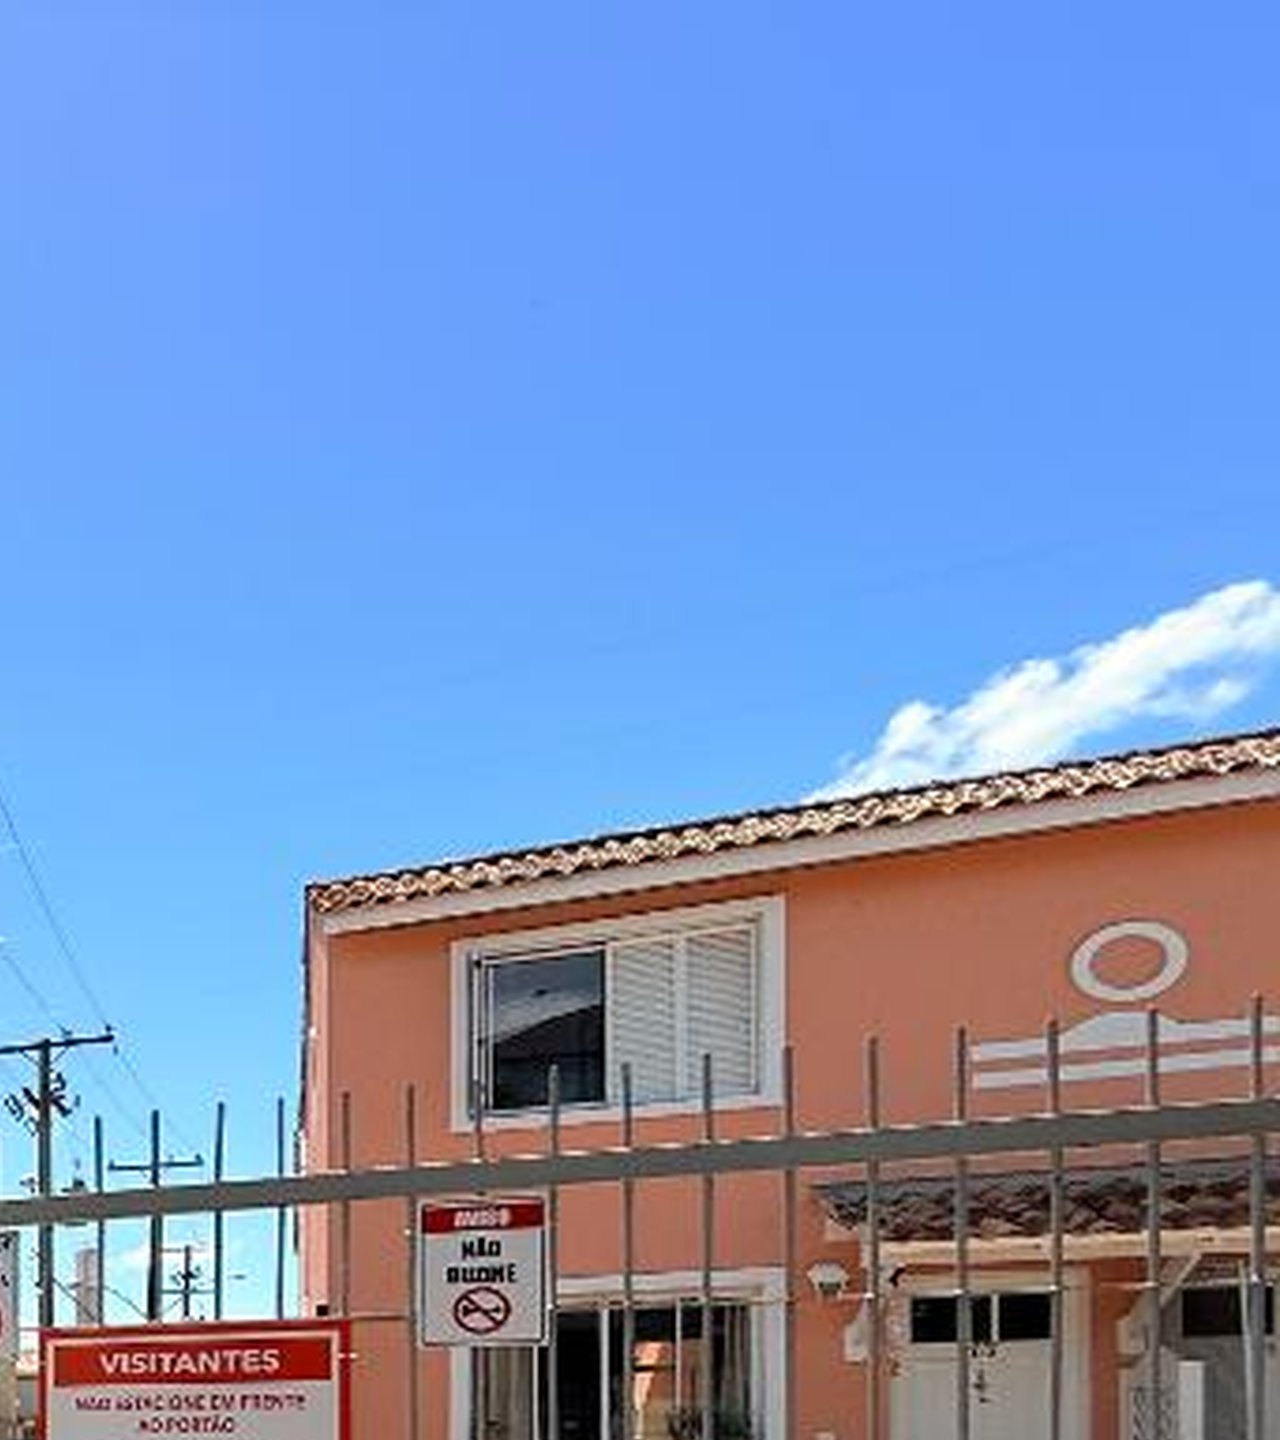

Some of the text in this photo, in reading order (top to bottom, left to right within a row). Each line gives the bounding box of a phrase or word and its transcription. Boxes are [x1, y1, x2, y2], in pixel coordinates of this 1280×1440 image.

[454, 1209, 512, 1228] AVISO
[460, 1235, 502, 1259] NÃO
[100, 1348, 281, 1375] VISITANTES
[166, 1414, 236, 1433] PORTÃO
